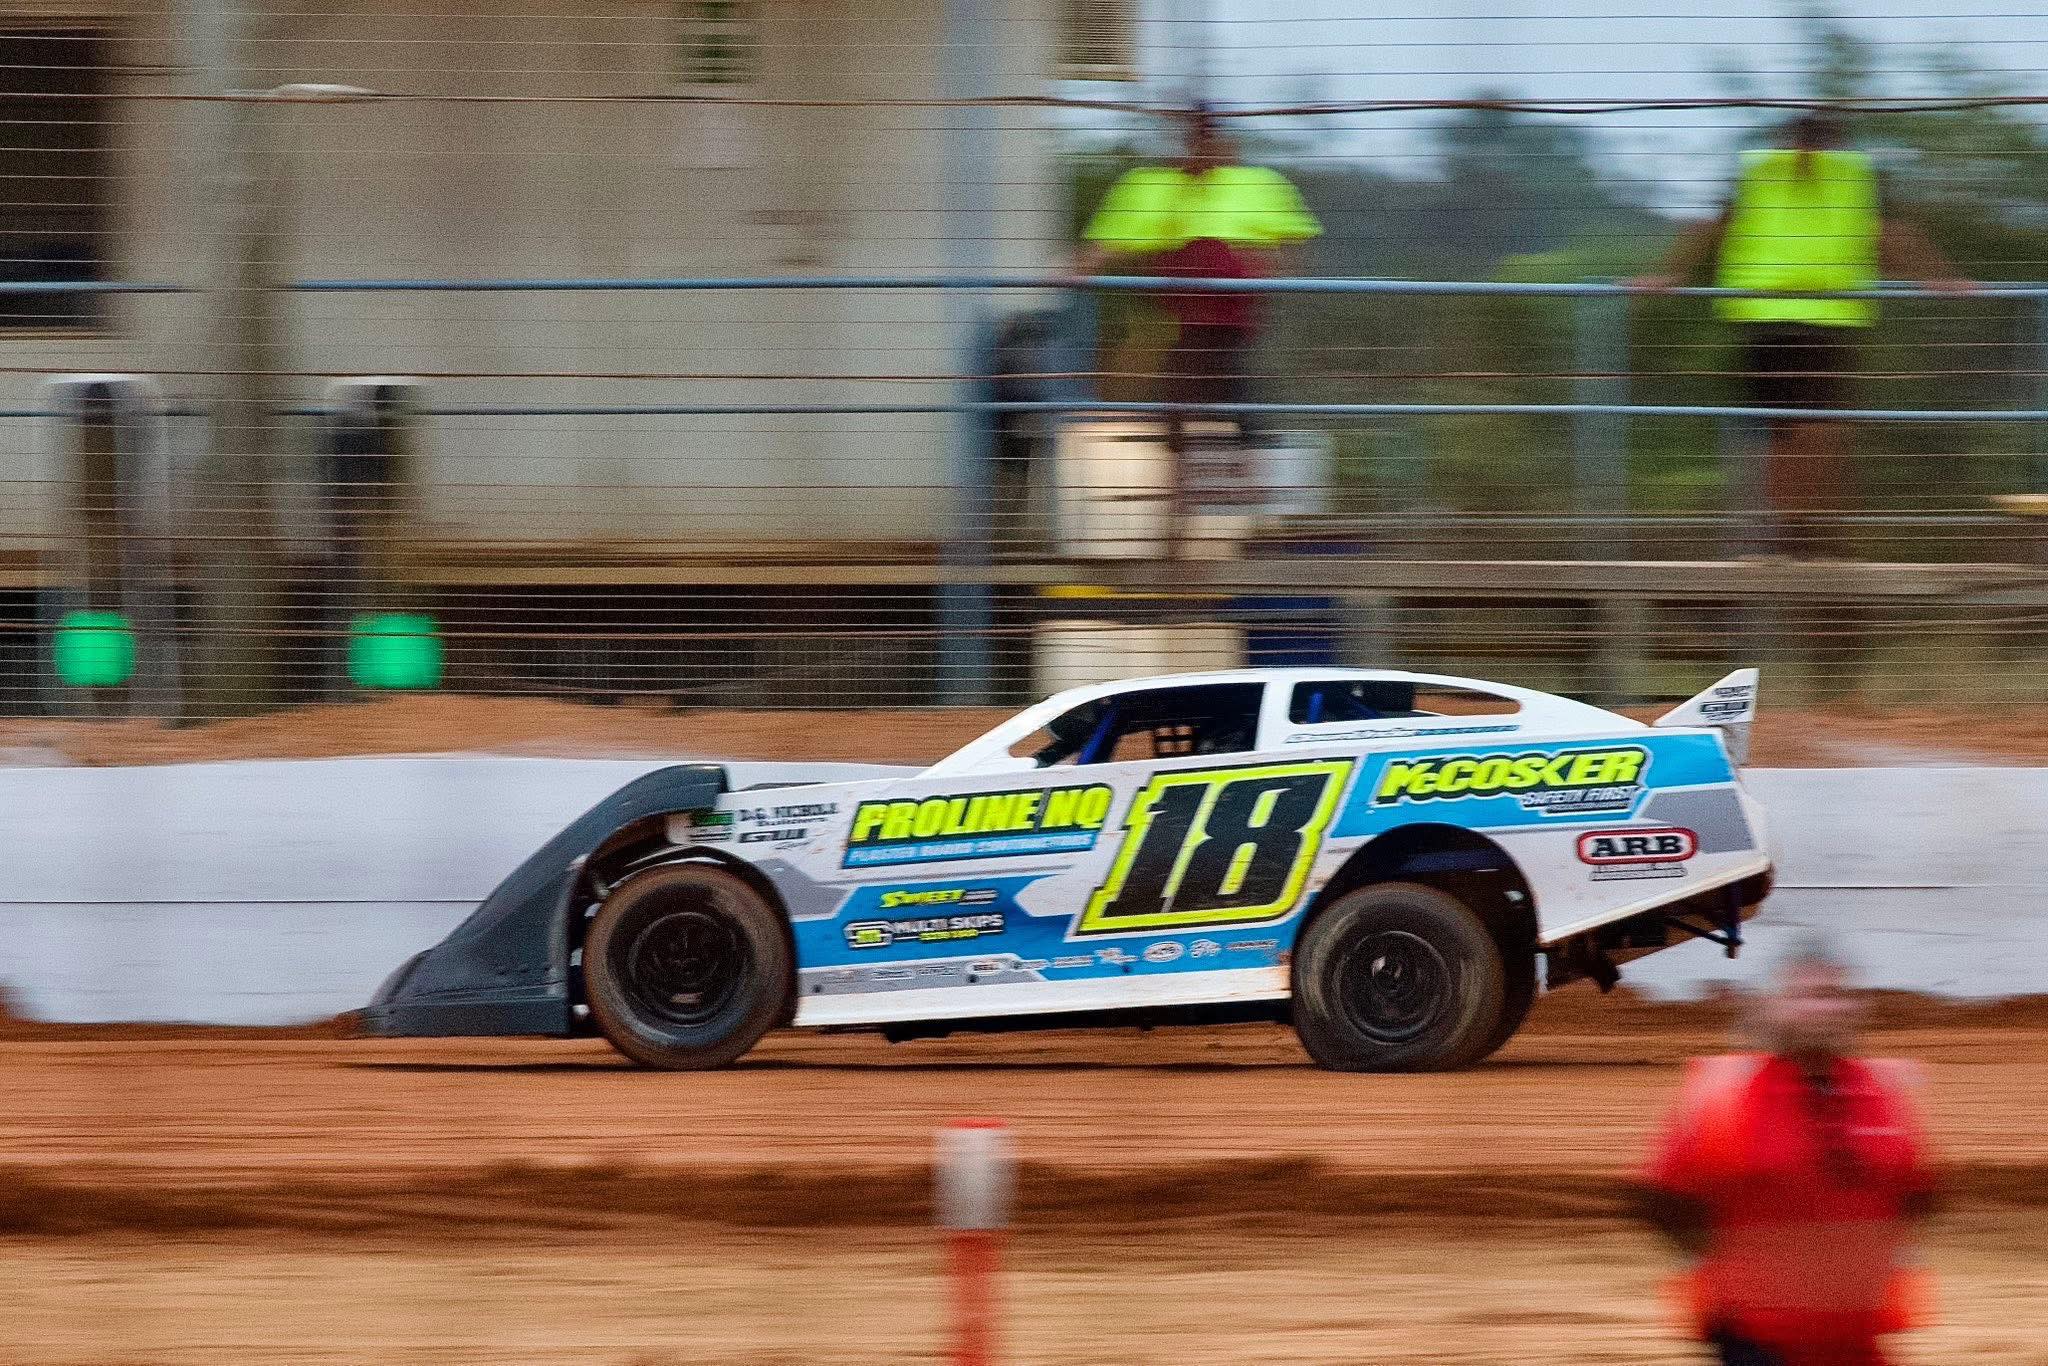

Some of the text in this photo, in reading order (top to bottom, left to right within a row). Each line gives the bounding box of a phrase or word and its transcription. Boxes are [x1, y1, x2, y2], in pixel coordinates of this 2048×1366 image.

[1582, 784, 1641, 802] FIRST
[850, 786, 1114, 843] PROLINE NQ
[1098, 770, 1333, 920] 18
[1590, 835, 1683, 858] ARB
[948, 914, 1004, 930] SKIPS
